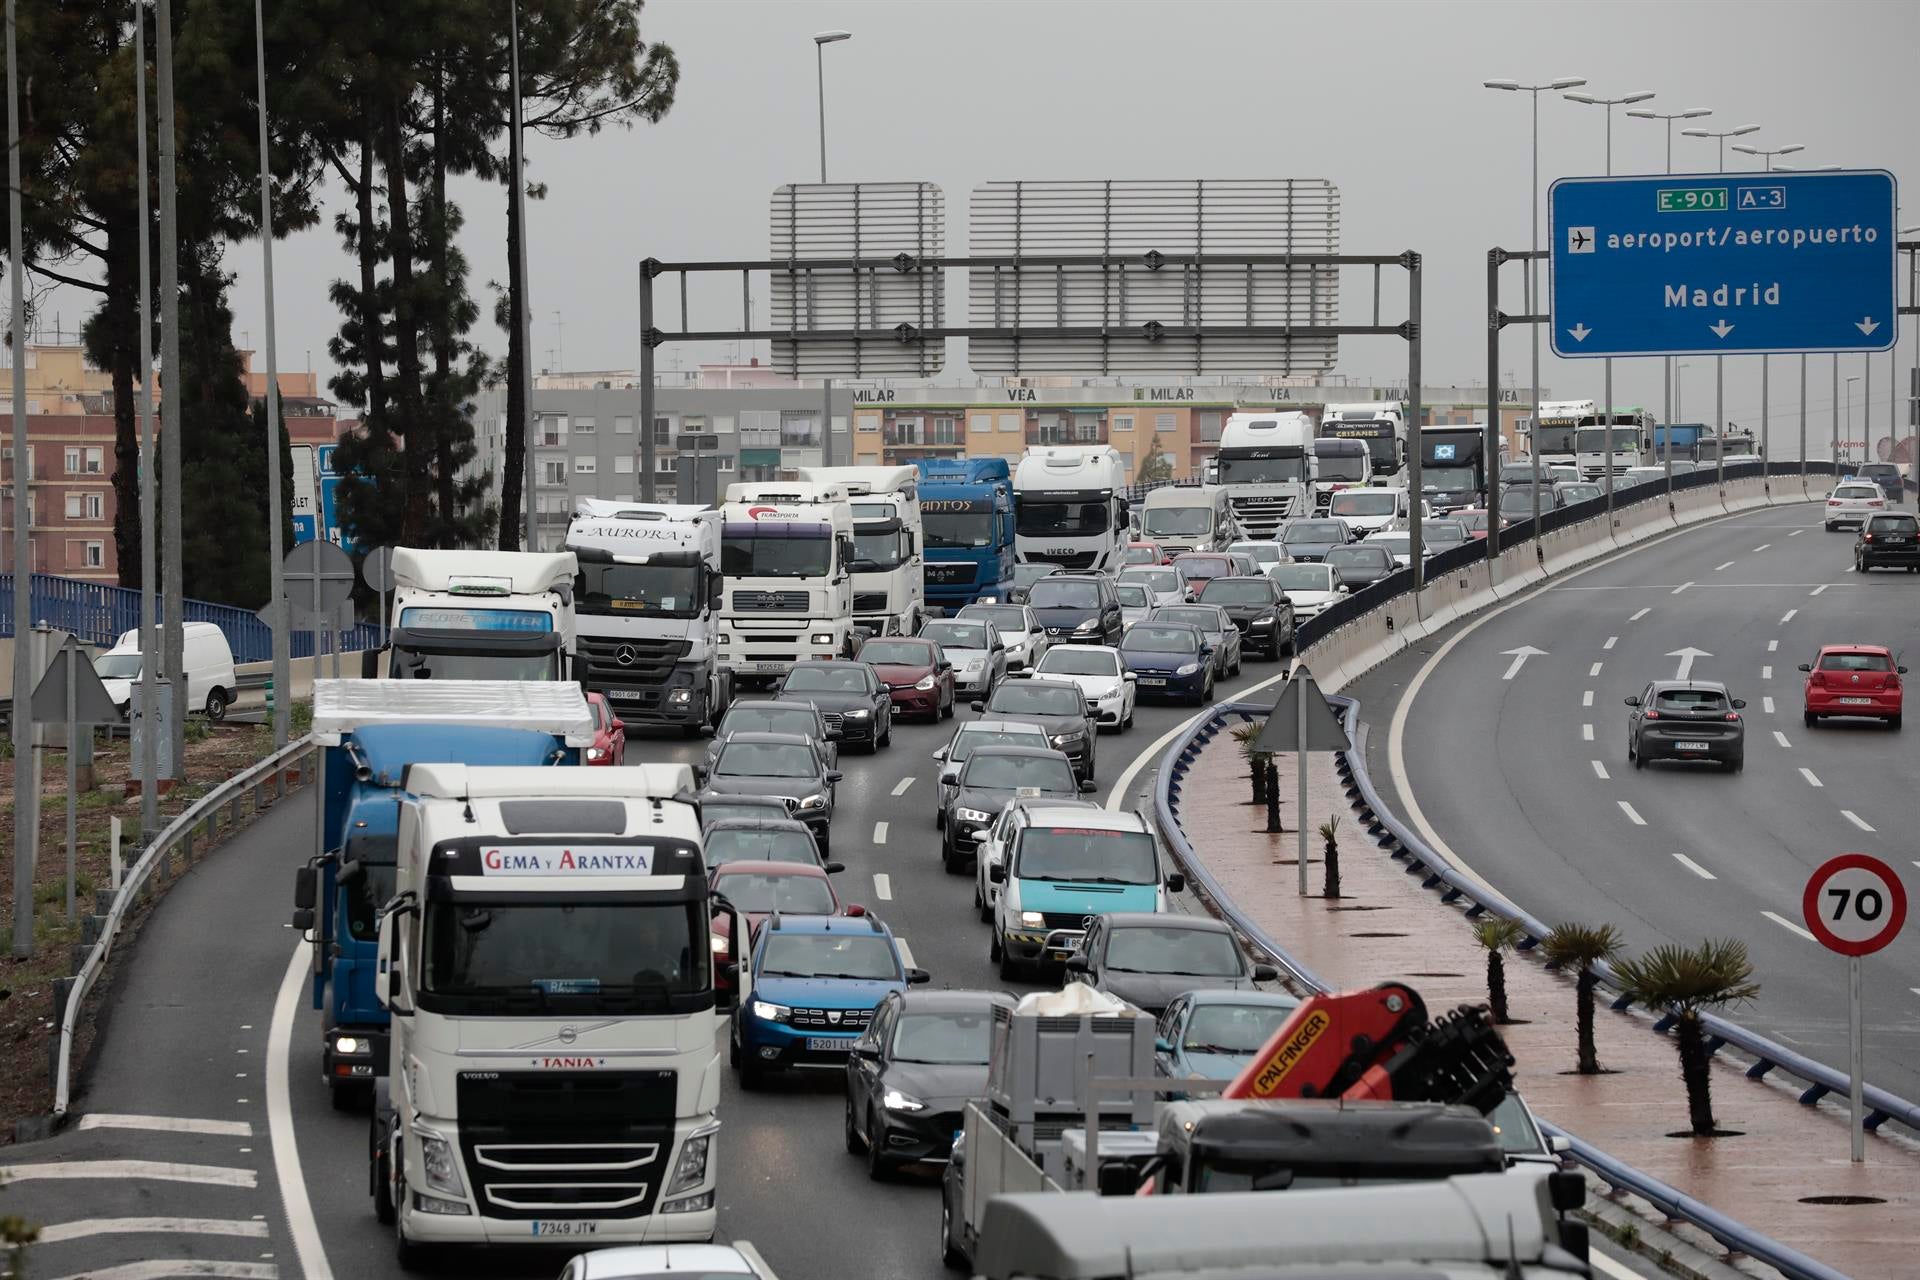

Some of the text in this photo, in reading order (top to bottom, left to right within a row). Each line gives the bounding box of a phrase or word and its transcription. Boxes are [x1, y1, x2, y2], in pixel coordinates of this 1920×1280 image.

[1661, 190, 1782, 208] E-901 A-3
[1607, 224, 1878, 252] aeroport/aeropuerto
[1665, 283, 1780, 307] Madrid
[853, 390, 895, 402] MILAR
[1008, 389, 1037, 401] VEA
[1151, 388, 1194, 400] MILAR
[1270, 388, 1291, 400] VEA
[1385, 389, 1409, 401] MILA
[588, 527, 677, 540] AURORA
[757, 594, 785, 602] MAN
[485, 850, 540, 869] GEMA
[559, 850, 648, 869] ARANTXA
[1828, 888, 1882, 921] 70
[813, 1040, 837, 1049] 5201
[1258, 1015, 1326, 1090] PALFINGER
[542, 1058, 595, 1067] TANIA
[541, 1222, 596, 1233] 7349 JTW
